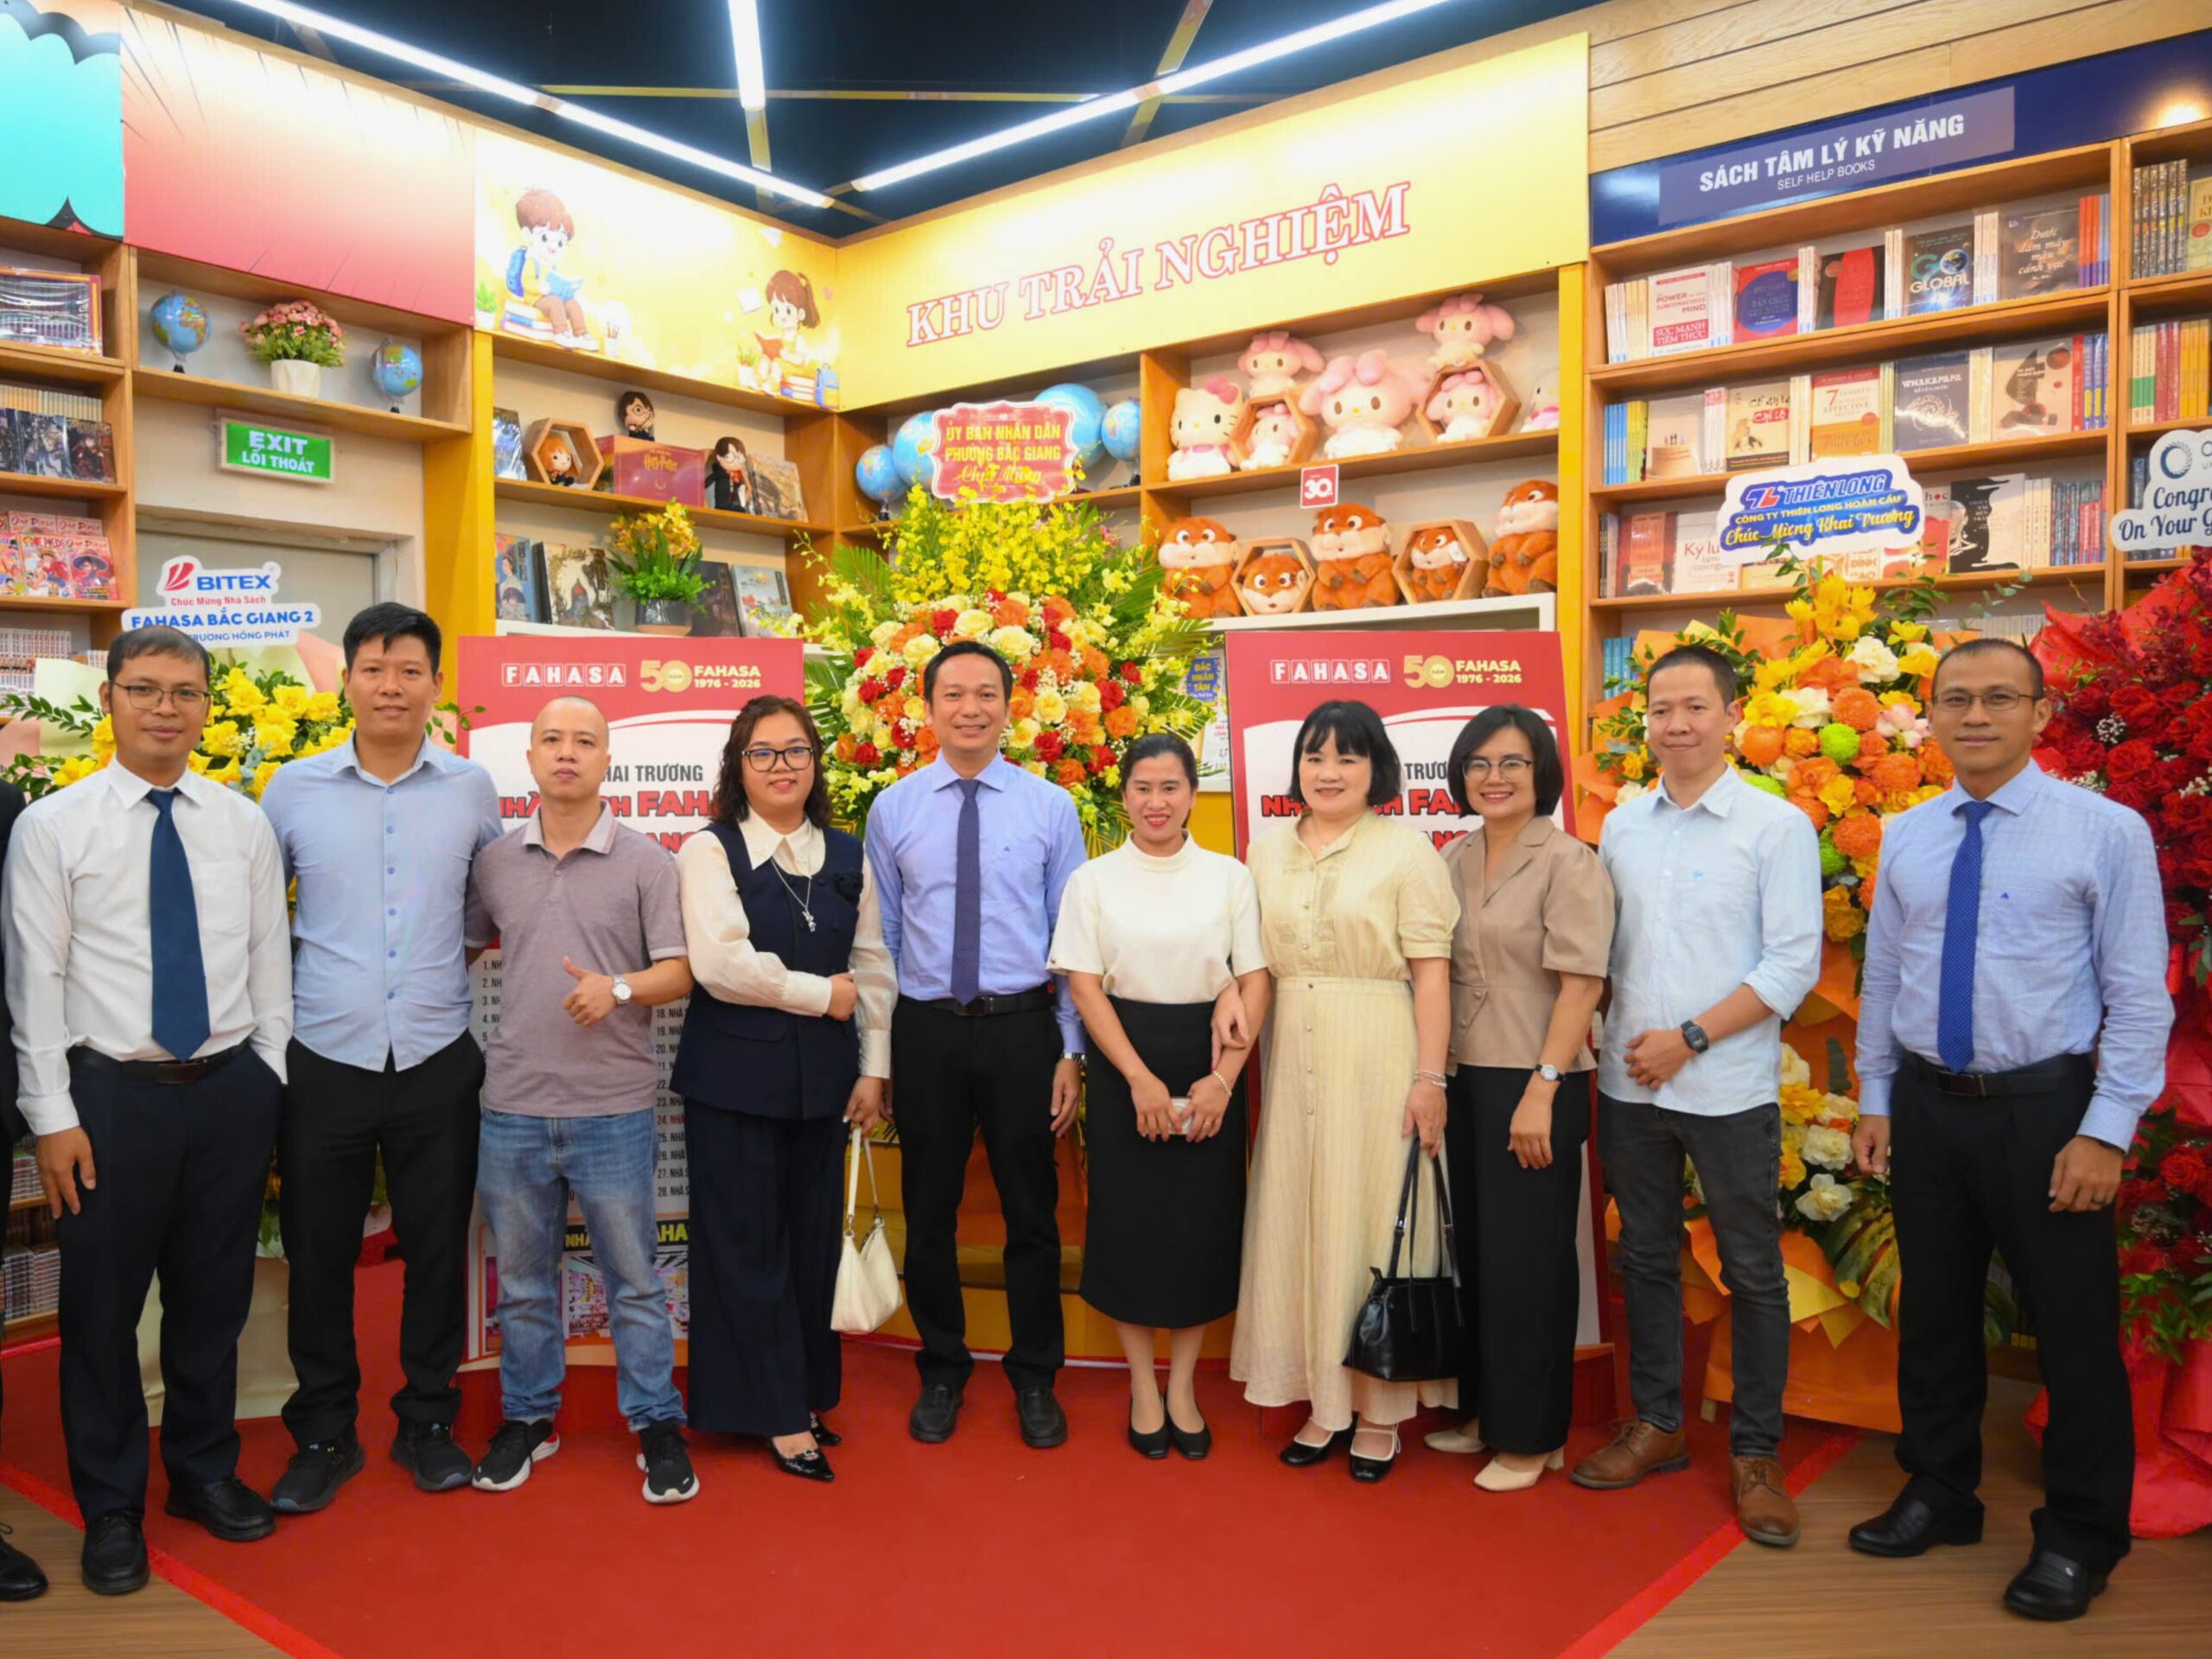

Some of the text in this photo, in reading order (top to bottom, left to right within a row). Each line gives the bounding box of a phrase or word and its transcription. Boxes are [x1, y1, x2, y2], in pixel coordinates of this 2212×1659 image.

[1700, 114, 1964, 192] SÁCH TÂM LÝ KỸ NĂNG
[1777, 159, 1876, 191] SELF HELP BOOKS
[906, 182, 1411, 347] KHU TRẢI NGHIỆM
[1910, 273, 1970, 293] GLOBAL
[1656, 292, 1688, 302] POWER
[1682, 303, 1706, 313] MIND
[946, 421, 1061, 442] ỦY BAN NHÂN DÂN
[249, 430, 308, 455] EXIT
[242, 448, 315, 474] LỐI THOÁT
[1024, 445, 1061, 461] GIANG
[1735, 513, 1764, 524] CÔNG
[1765, 512, 1778, 520] TY
[1781, 506, 1811, 518] THIÊN
[1814, 503, 1843, 513] LONG
[1846, 499, 1877, 509] HOÀN
[1726, 527, 1760, 545] Chúc
[1772, 522, 1815, 541] Mừng
[1815, 514, 1854, 533] Khai
[2119, 518, 2147, 542] On
[2150, 514, 2197, 537] Your
[196, 575, 272, 591] BITEX
[131, 607, 314, 629] FAHASA BẮC GIANG 2
[505, 660, 761, 693] FAHASA 50 FAHASA
[1274, 655, 1522, 688] FAHASA 50 FAHASA
[1456, 674, 1483, 683] 1976
[1493, 674, 1522, 683] 2026
[694, 679, 721, 689] 1976
[732, 679, 761, 689] 2026
[635, 763, 703, 782] TRƯƠNG
[1404, 761, 1448, 780] TRƯƠ
[484, 960, 490, 970] 1.
[482, 978, 490, 988] 2.
[482, 995, 490, 1006] 3.
[482, 1014, 489, 1024] 4.
[657, 1006, 683, 1019] 18. NHÀ
[657, 1027, 668, 1036] 19.
[656, 1044, 667, 1054] 20.
[658, 1097, 669, 1107] 23.
[658, 1115, 668, 1125] 24.
[671, 1147, 685, 1160] NHÀ
[658, 1166, 683, 1179] 27. NHÀ
[658, 1184, 684, 1197] 28. NHÀ
